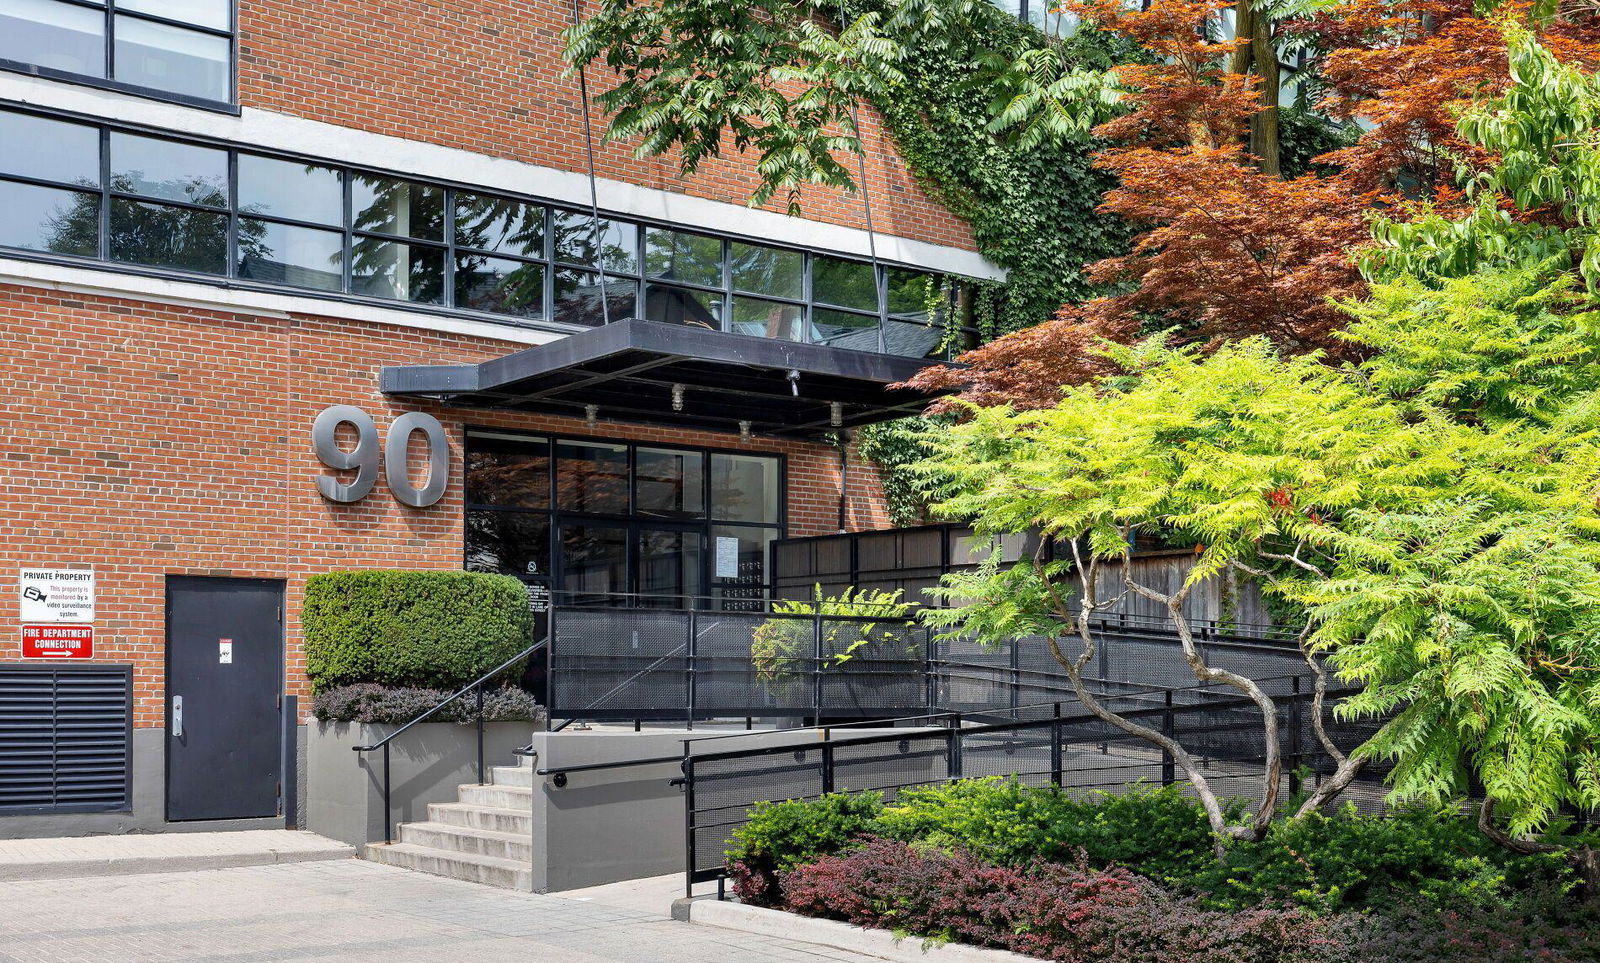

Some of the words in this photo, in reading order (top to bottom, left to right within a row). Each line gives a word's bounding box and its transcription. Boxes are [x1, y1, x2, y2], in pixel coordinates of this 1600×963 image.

[312, 405, 449, 507] 90
[24, 572, 52, 580] PRIVATE
[55, 573, 91, 581] PROPERTY
[24, 629, 40, 637] FIRE
[43, 629, 91, 638] DEPARTMENT
[35, 640, 81, 648] CONNECTION
